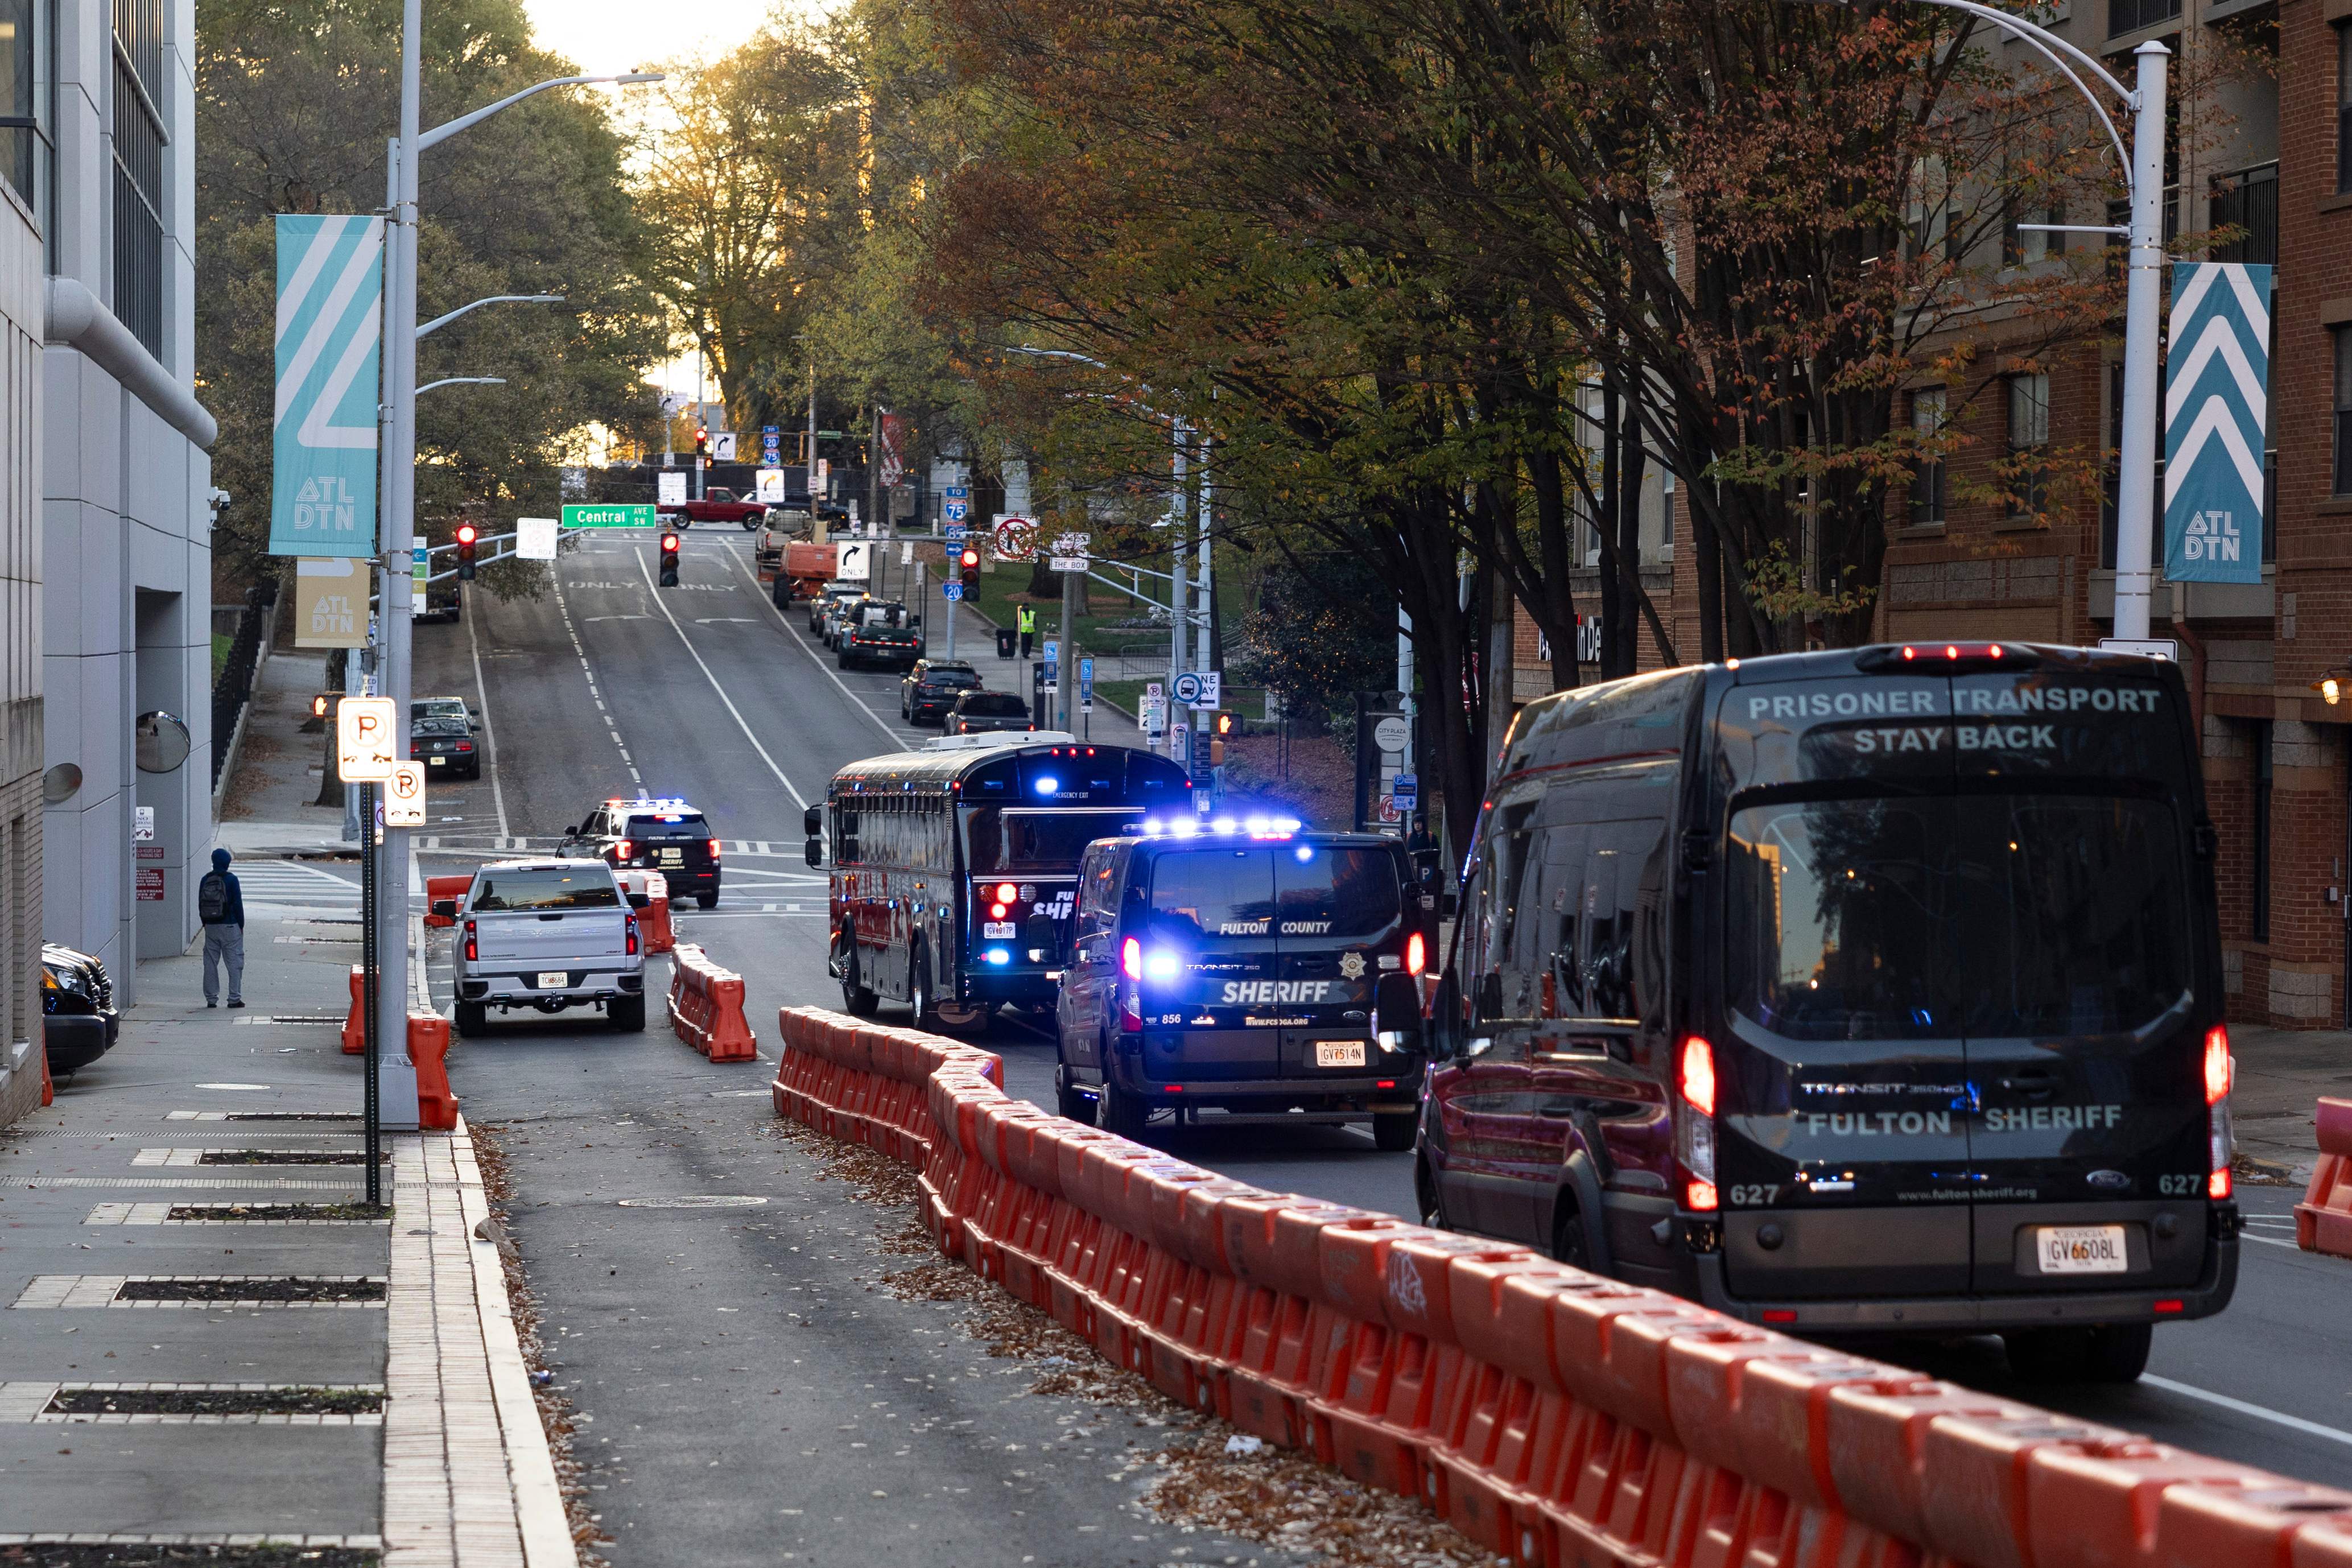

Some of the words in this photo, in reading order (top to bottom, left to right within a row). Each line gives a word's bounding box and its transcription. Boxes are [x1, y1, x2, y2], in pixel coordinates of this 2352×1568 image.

[768, 439, 777, 447] 20
[296, 477, 354, 503] ATL
[294, 504, 354, 530] DTN
[577, 510, 625, 522] Central
[948, 506, 963, 514] 75
[2186, 511, 2239, 535] ATL
[2185, 536, 2239, 561] DTN
[947, 587, 960, 597] 20
[313, 596, 353, 614] ATL
[312, 614, 353, 633] DTN
[1201, 675, 1216, 684] NE
[1749, 690, 1934, 719] PRISONER
[1948, 688, 2160, 713] TRANSPORT
[1855, 728, 1945, 753] STAY
[1957, 725, 2056, 750] BACK
[1220, 922, 1268, 935] FULTON
[1281, 921, 1332, 934] COUNTY
[1222, 981, 1331, 1002] SHERIFF
[1162, 1014, 1181, 1024] 856
[1323, 1049, 1361, 1059] GV7514N
[1801, 1083, 1906, 1094] TRANSIT
[1809, 1111, 1951, 1136] FULTON
[1985, 1105, 2122, 1131] SHERIFF
[2159, 1174, 2202, 1194] 627
[1730, 1184, 1780, 1204] 627
[2051, 1239, 2119, 1260] GV6608L
